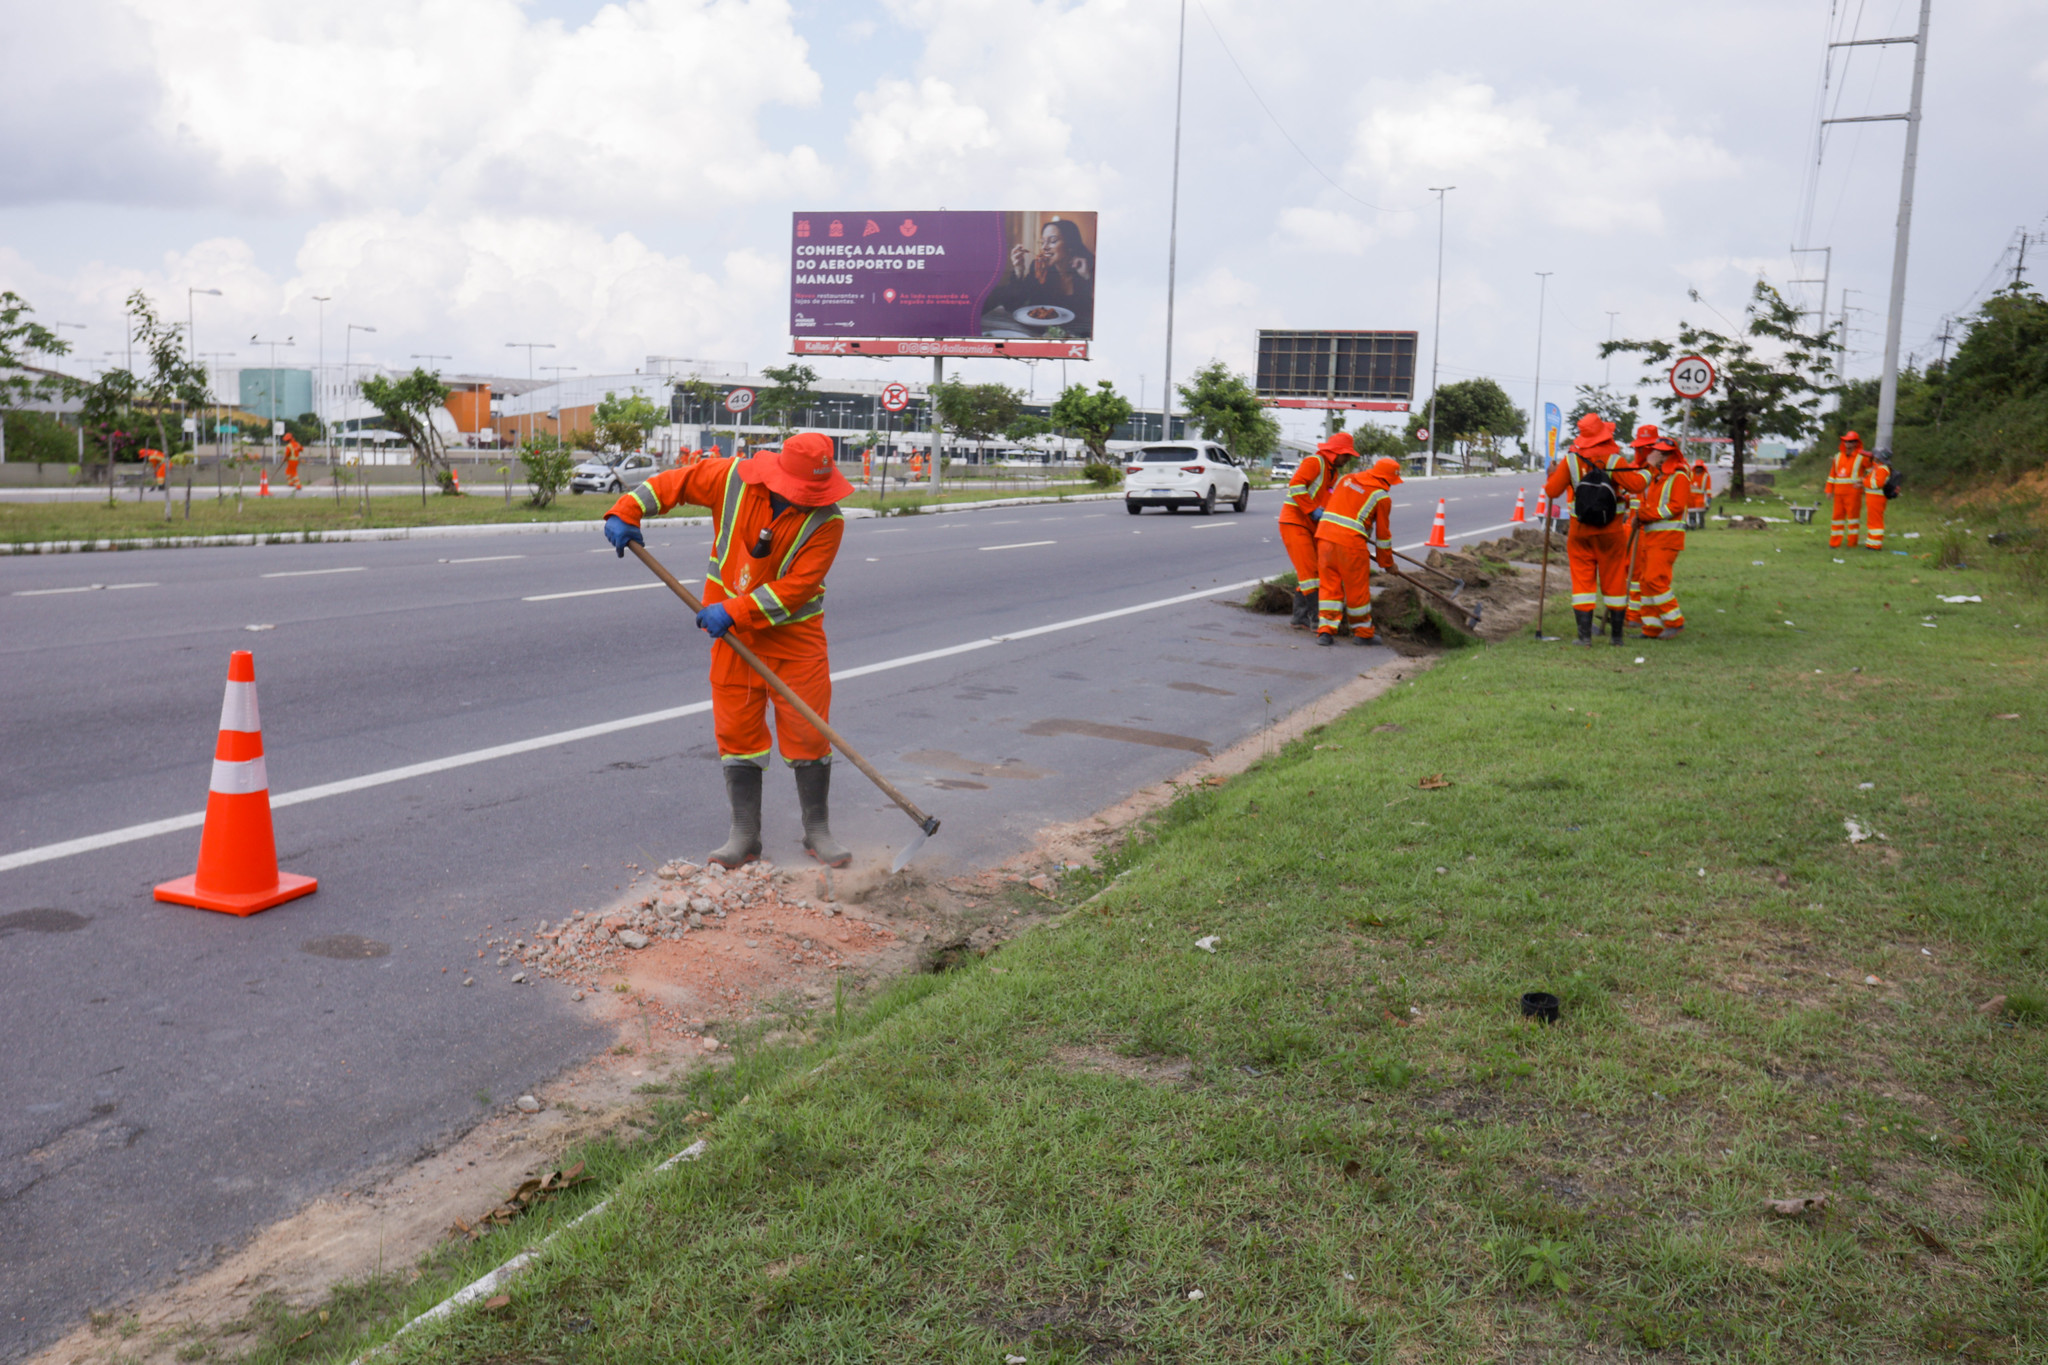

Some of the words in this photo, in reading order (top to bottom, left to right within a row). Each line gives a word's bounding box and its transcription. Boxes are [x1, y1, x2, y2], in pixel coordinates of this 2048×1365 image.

[796, 245, 863, 258] CONHEÇA
[865, 245, 875, 255] A
[877, 245, 945, 256] ALAMEDA
[796, 259, 816, 270] DO
[819, 259, 903, 270] AEROPORTO
[906, 259, 925, 270] DE
[796, 274, 853, 284] MANAUS
[805, 342, 830, 351] Kallas
[1678, 368, 1707, 384] 40
[730, 393, 750, 404] 40
